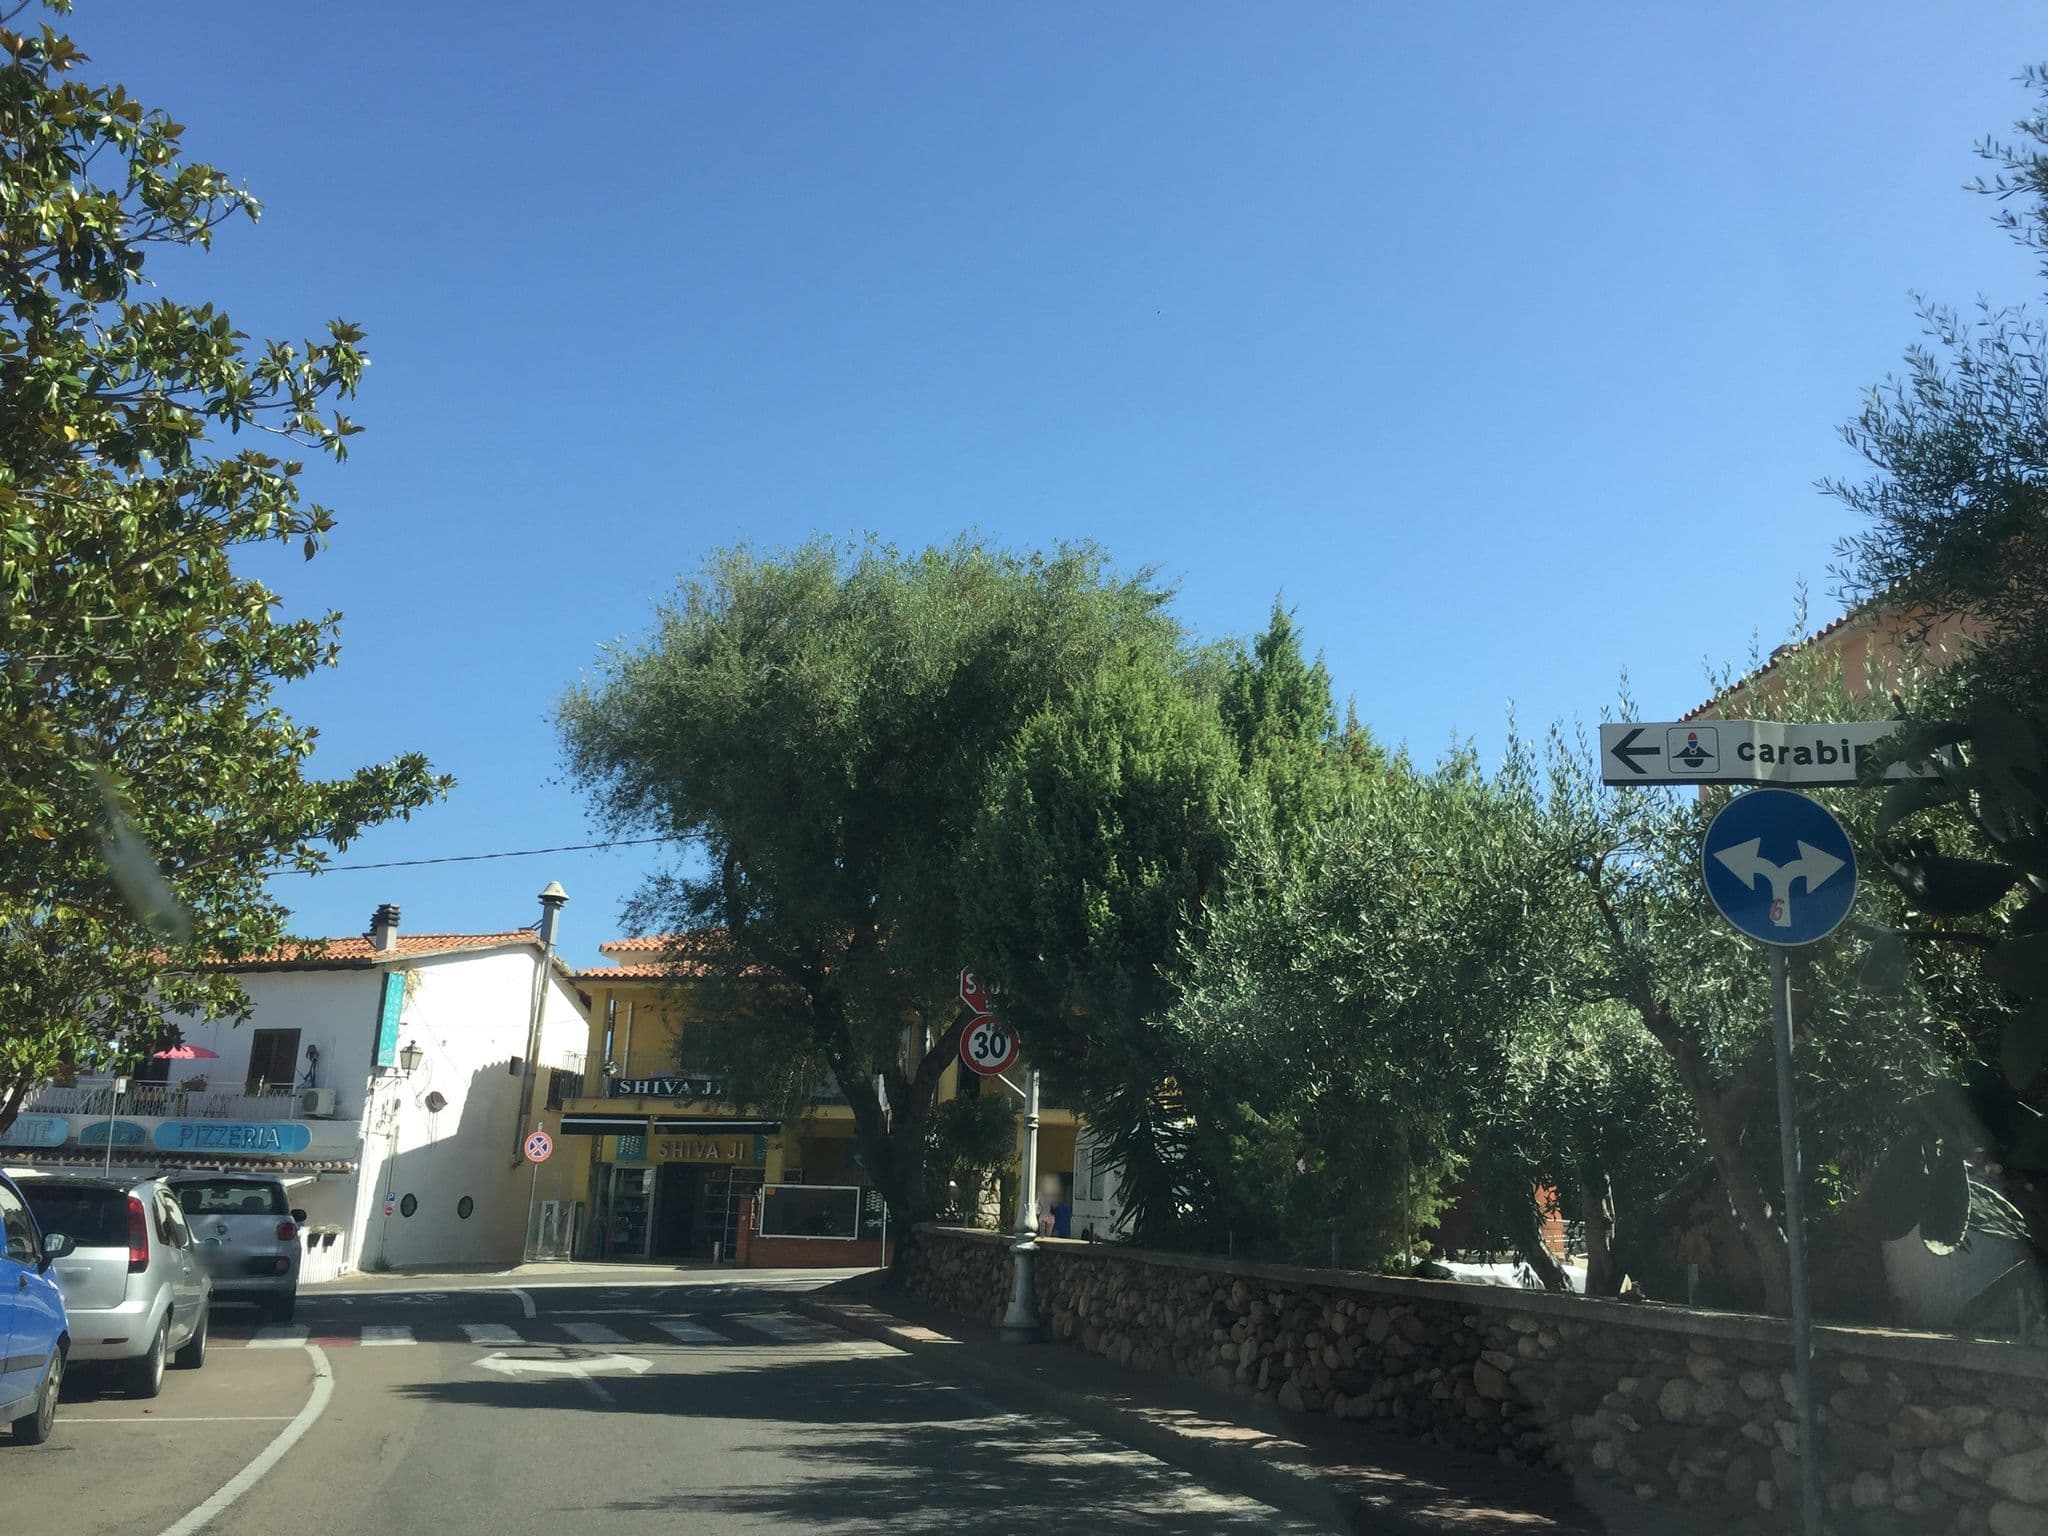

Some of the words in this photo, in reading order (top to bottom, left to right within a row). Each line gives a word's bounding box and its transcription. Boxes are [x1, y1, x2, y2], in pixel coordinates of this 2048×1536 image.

[974, 1031, 1006, 1059] 30
[619, 1080, 691, 1094] SHIVA
[178, 1125, 282, 1149] PIZZERIA
[659, 1140, 719, 1159] SHIVA
[727, 1141, 744, 1159] JI
